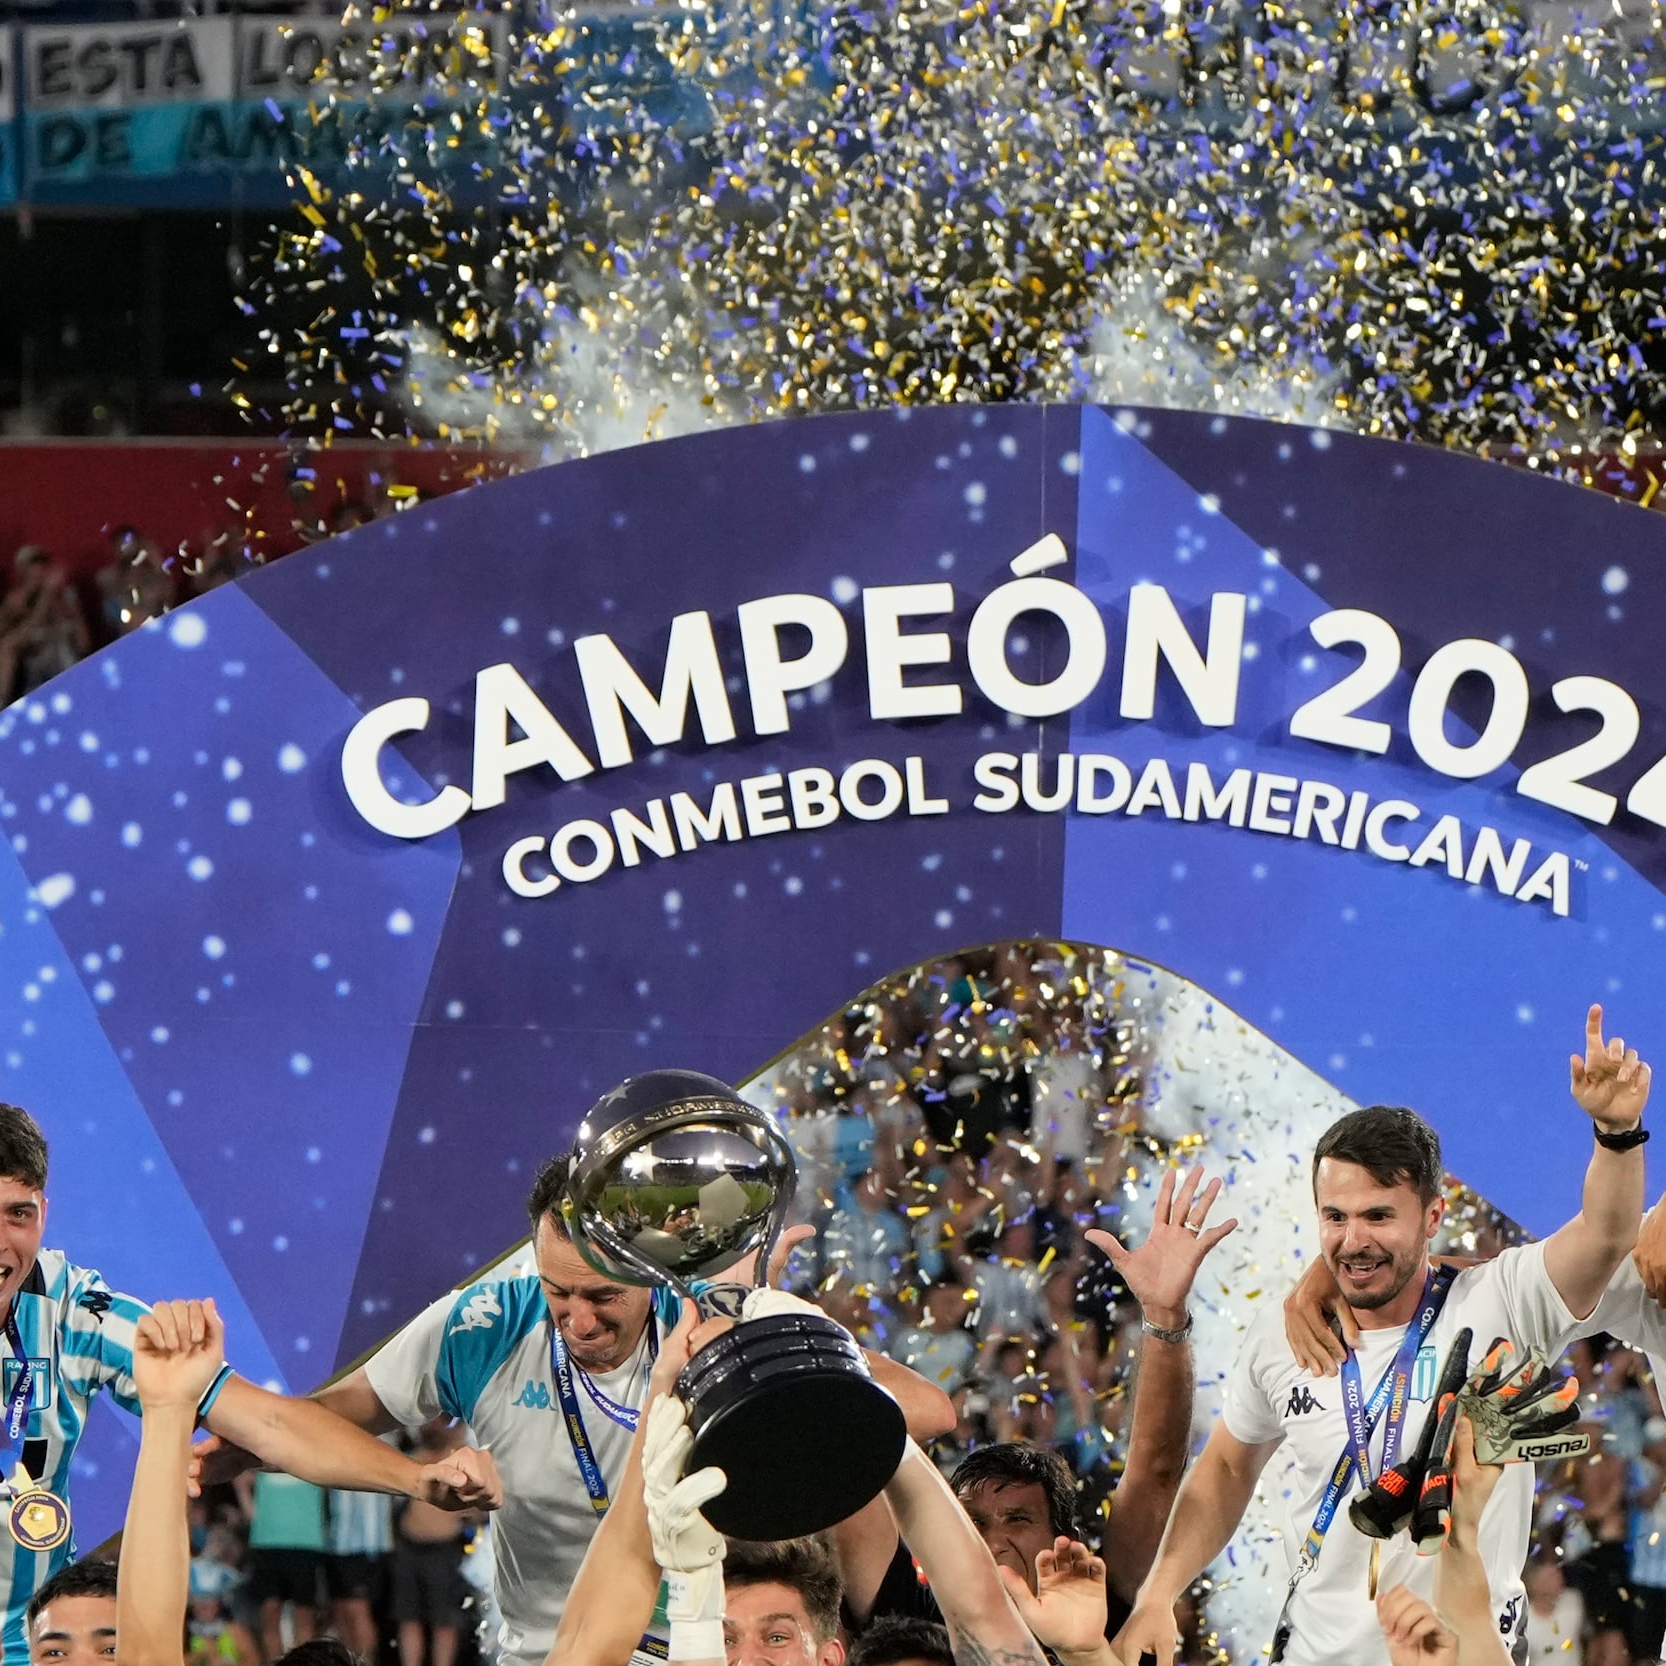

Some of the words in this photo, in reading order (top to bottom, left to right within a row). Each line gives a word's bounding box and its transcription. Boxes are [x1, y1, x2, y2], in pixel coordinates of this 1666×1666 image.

[38, 33, 201, 94] ESTA
[38, 118, 131, 168] DE
[341, 533, 1247, 840] CAMPEÓN
[502, 756, 949, 898] CONMEBOL
[973, 753, 1571, 916] SUDAMERICANA
[1347, 1380, 1361, 1404] 2024
[1389, 1373, 1407, 1423] ASUNCIÓN
[1351, 1406, 1364, 1444] FINAL
[1518, 1437, 1589, 1461] reusch
[578, 1446, 593, 1474] FINAL
[586, 1474, 601, 1497] 2024
[1325, 1485, 1340, 1508] FINAL
[1317, 1506, 1331, 1530] 2024
